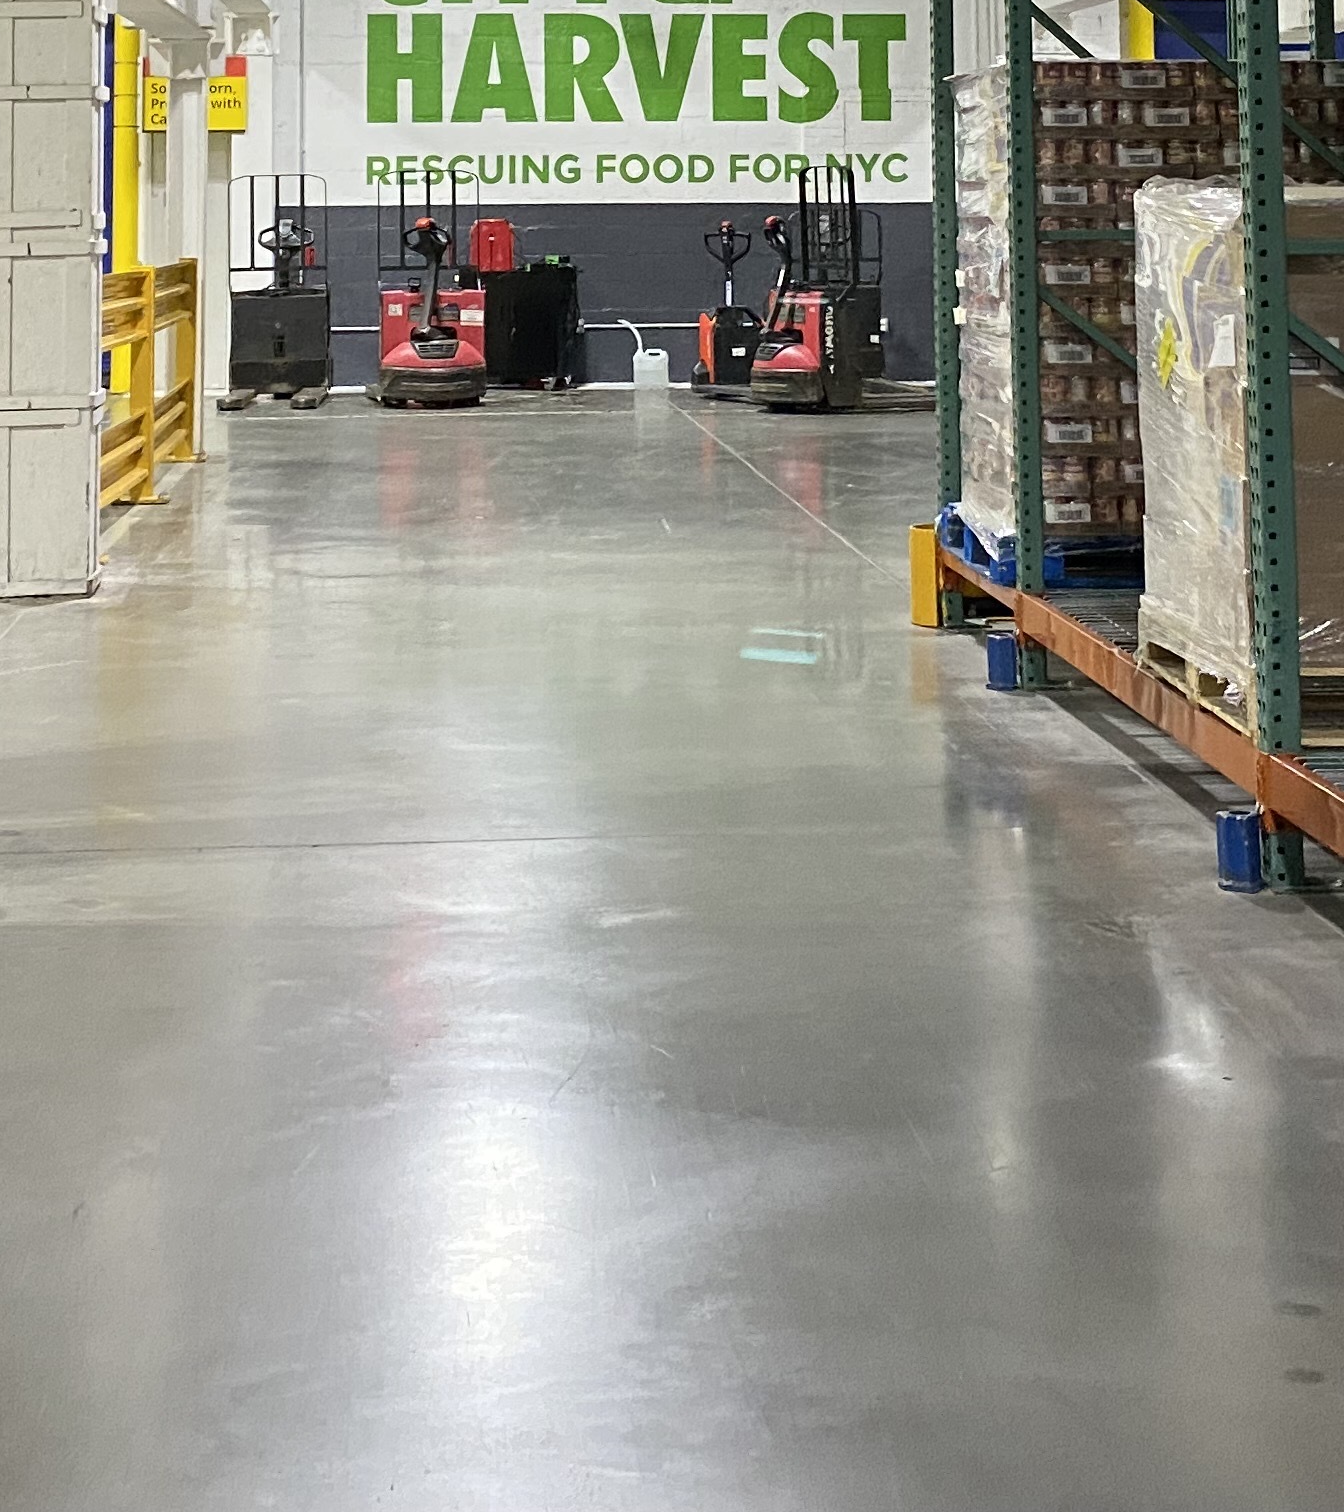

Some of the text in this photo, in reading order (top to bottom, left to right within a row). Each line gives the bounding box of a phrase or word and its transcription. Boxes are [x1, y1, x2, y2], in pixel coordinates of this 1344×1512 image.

[366, 11, 906, 124] HARVEST
[210, 96, 242, 109] with
[367, 153, 909, 186] RESCUING FOOD FOR NYC
